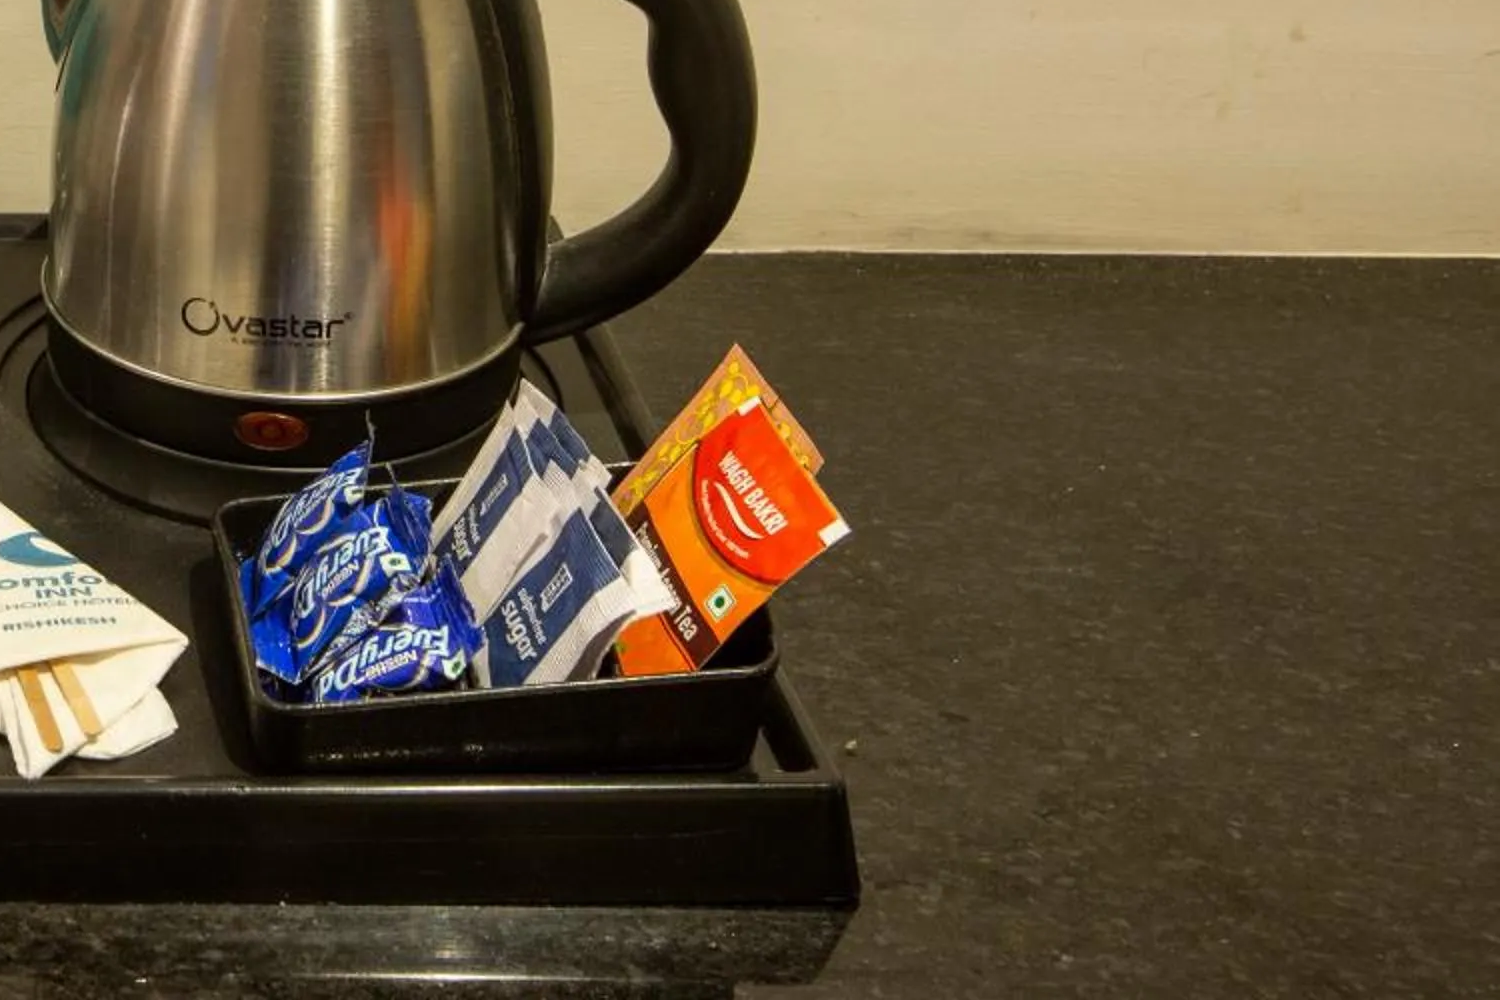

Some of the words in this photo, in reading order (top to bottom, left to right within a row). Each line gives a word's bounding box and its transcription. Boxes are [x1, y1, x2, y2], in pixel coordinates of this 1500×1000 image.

[181, 297, 345, 339] Ovastar
[718, 450, 757, 496] WAGH
[743, 487, 789, 536] BAKRI
[35, 585, 94, 599] INN
[2, 615, 118, 633] RISHIKESH
[501, 600, 538, 661] sugar
[674, 604, 698, 642] Tea
